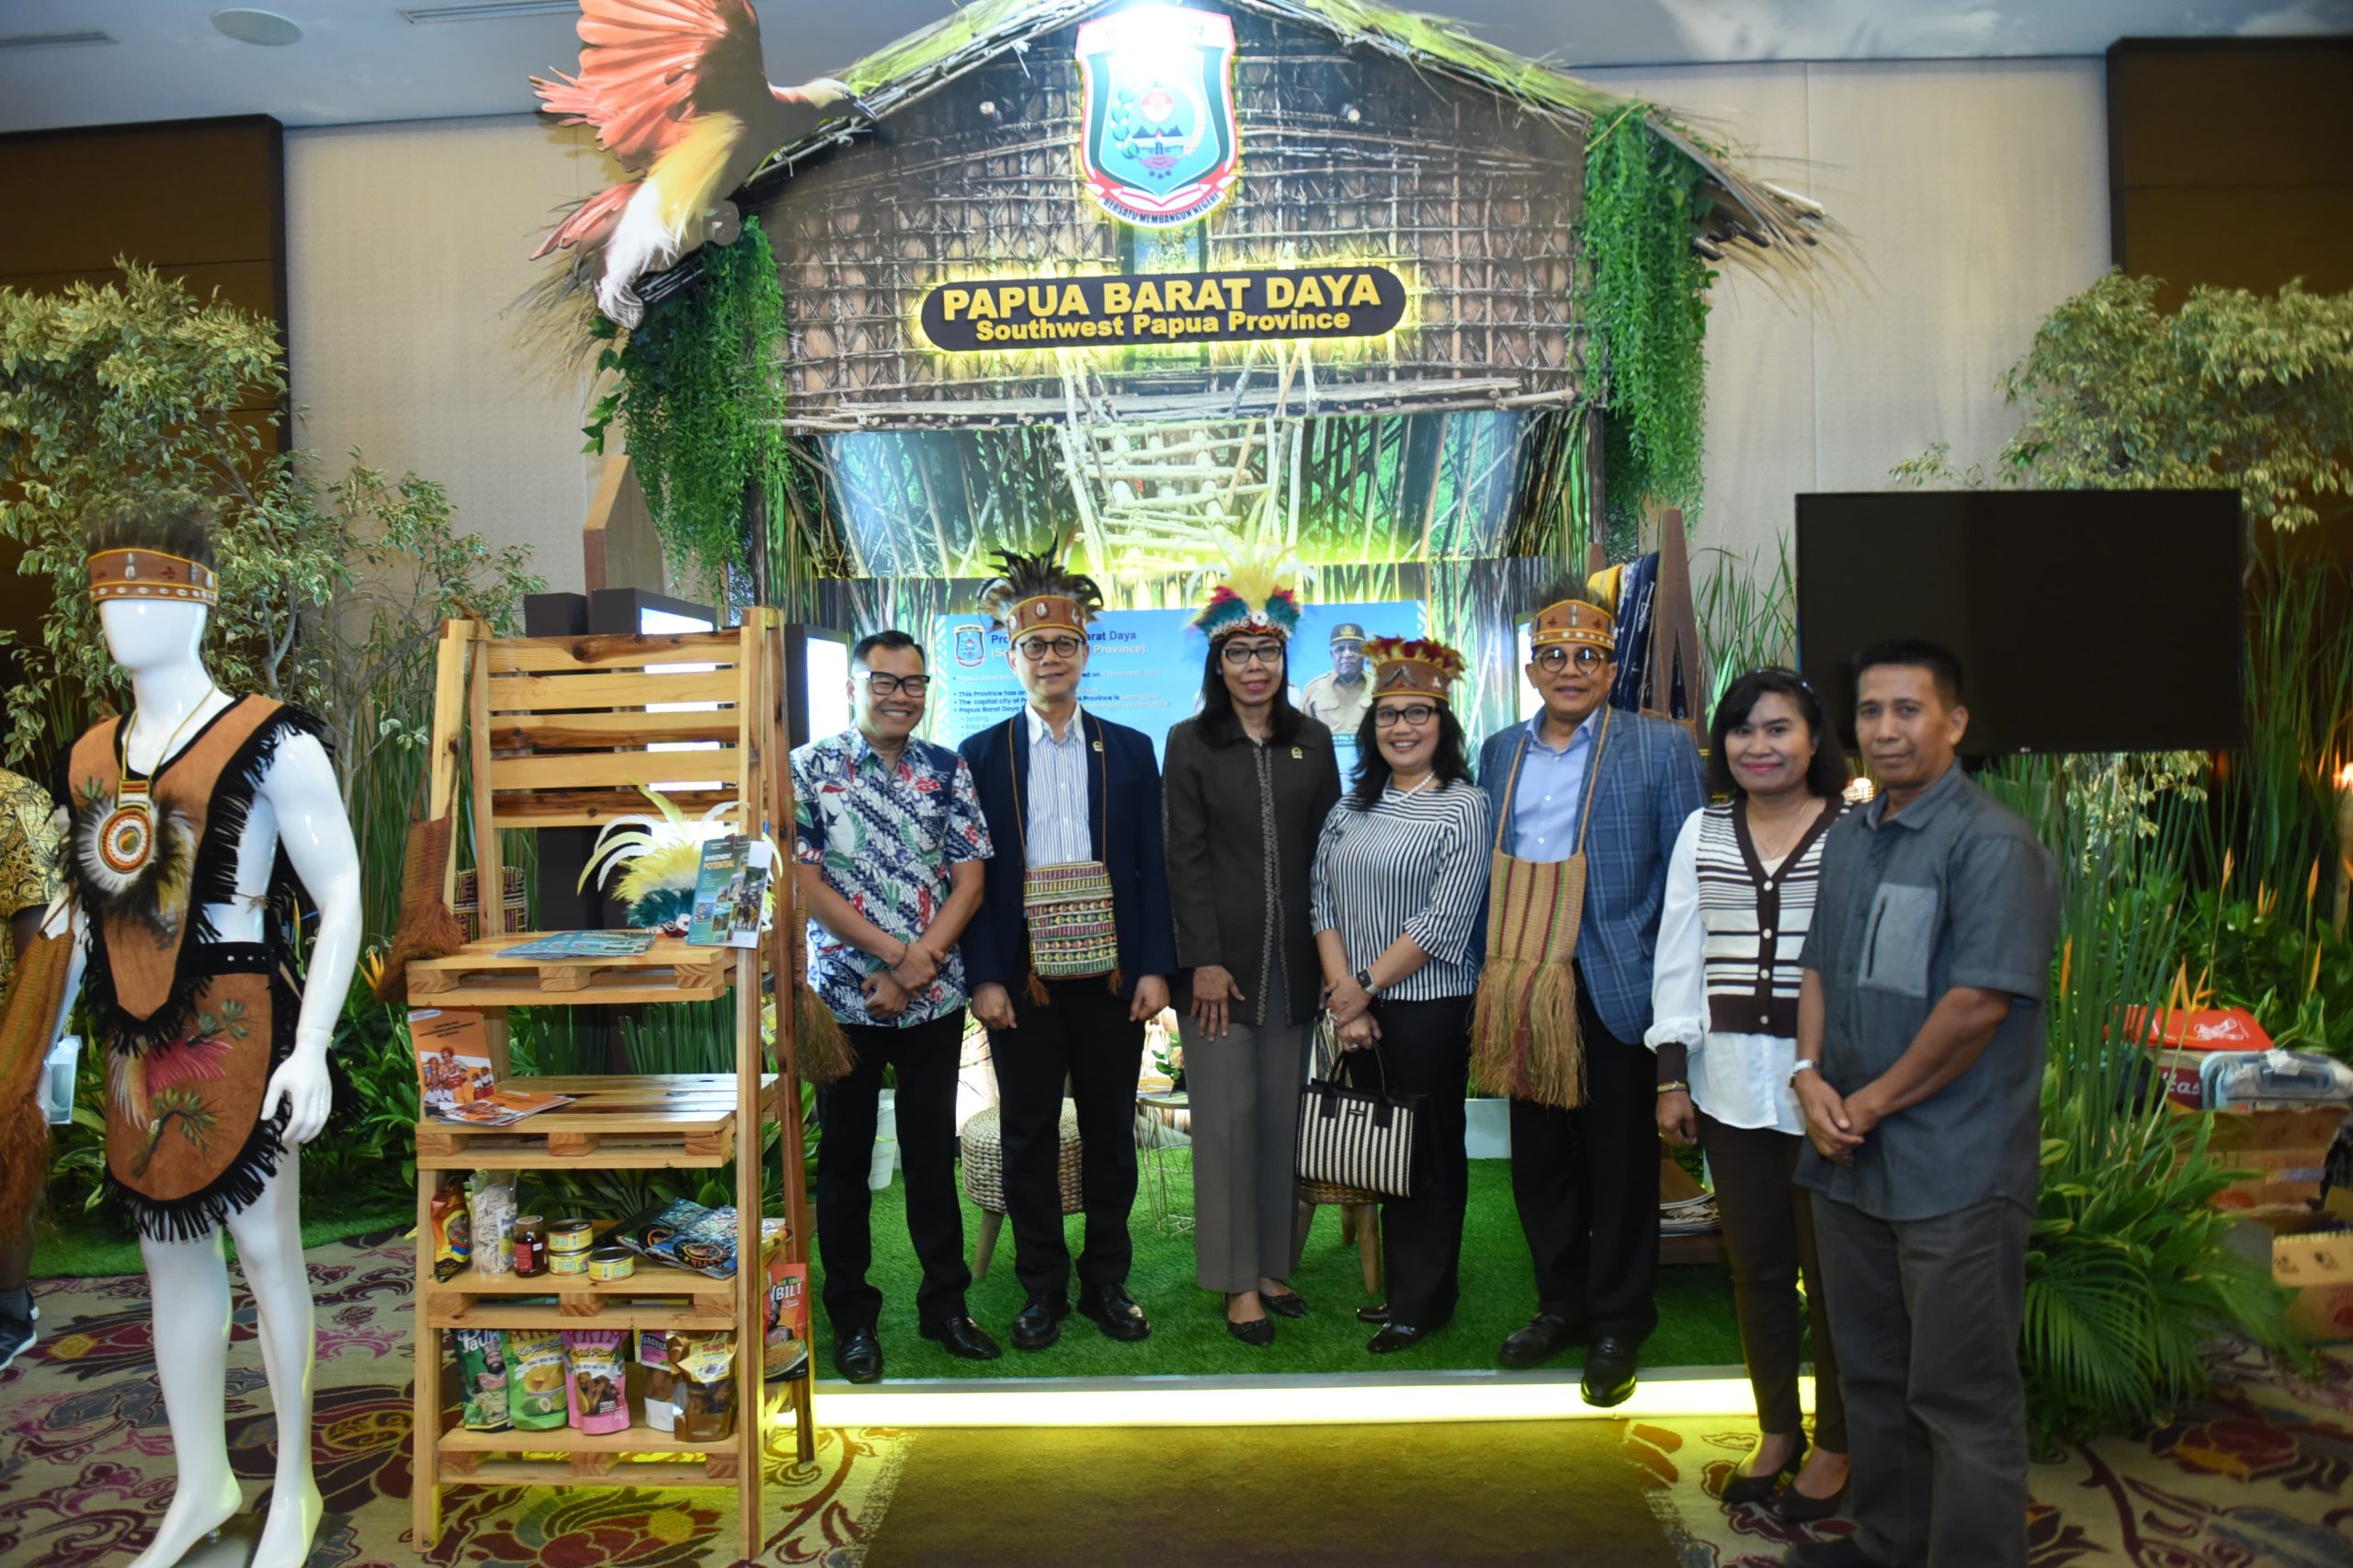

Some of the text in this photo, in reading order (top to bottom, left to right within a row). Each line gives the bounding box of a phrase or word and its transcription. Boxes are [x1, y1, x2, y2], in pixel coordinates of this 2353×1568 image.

[1103, 192, 1221, 224] BERSATU MEMBANGUN NEGERI
[943, 273, 1382, 322] PAPUA BARAT DAYA
[975, 309, 1352, 343] Southwest Papua Province
[1109, 630, 1137, 642] Daya
[1094, 644, 1147, 655] Province)
[973, 698, 998, 706] capital
[999, 697, 1011, 706] city
[1002, 704, 1020, 713] Daya
